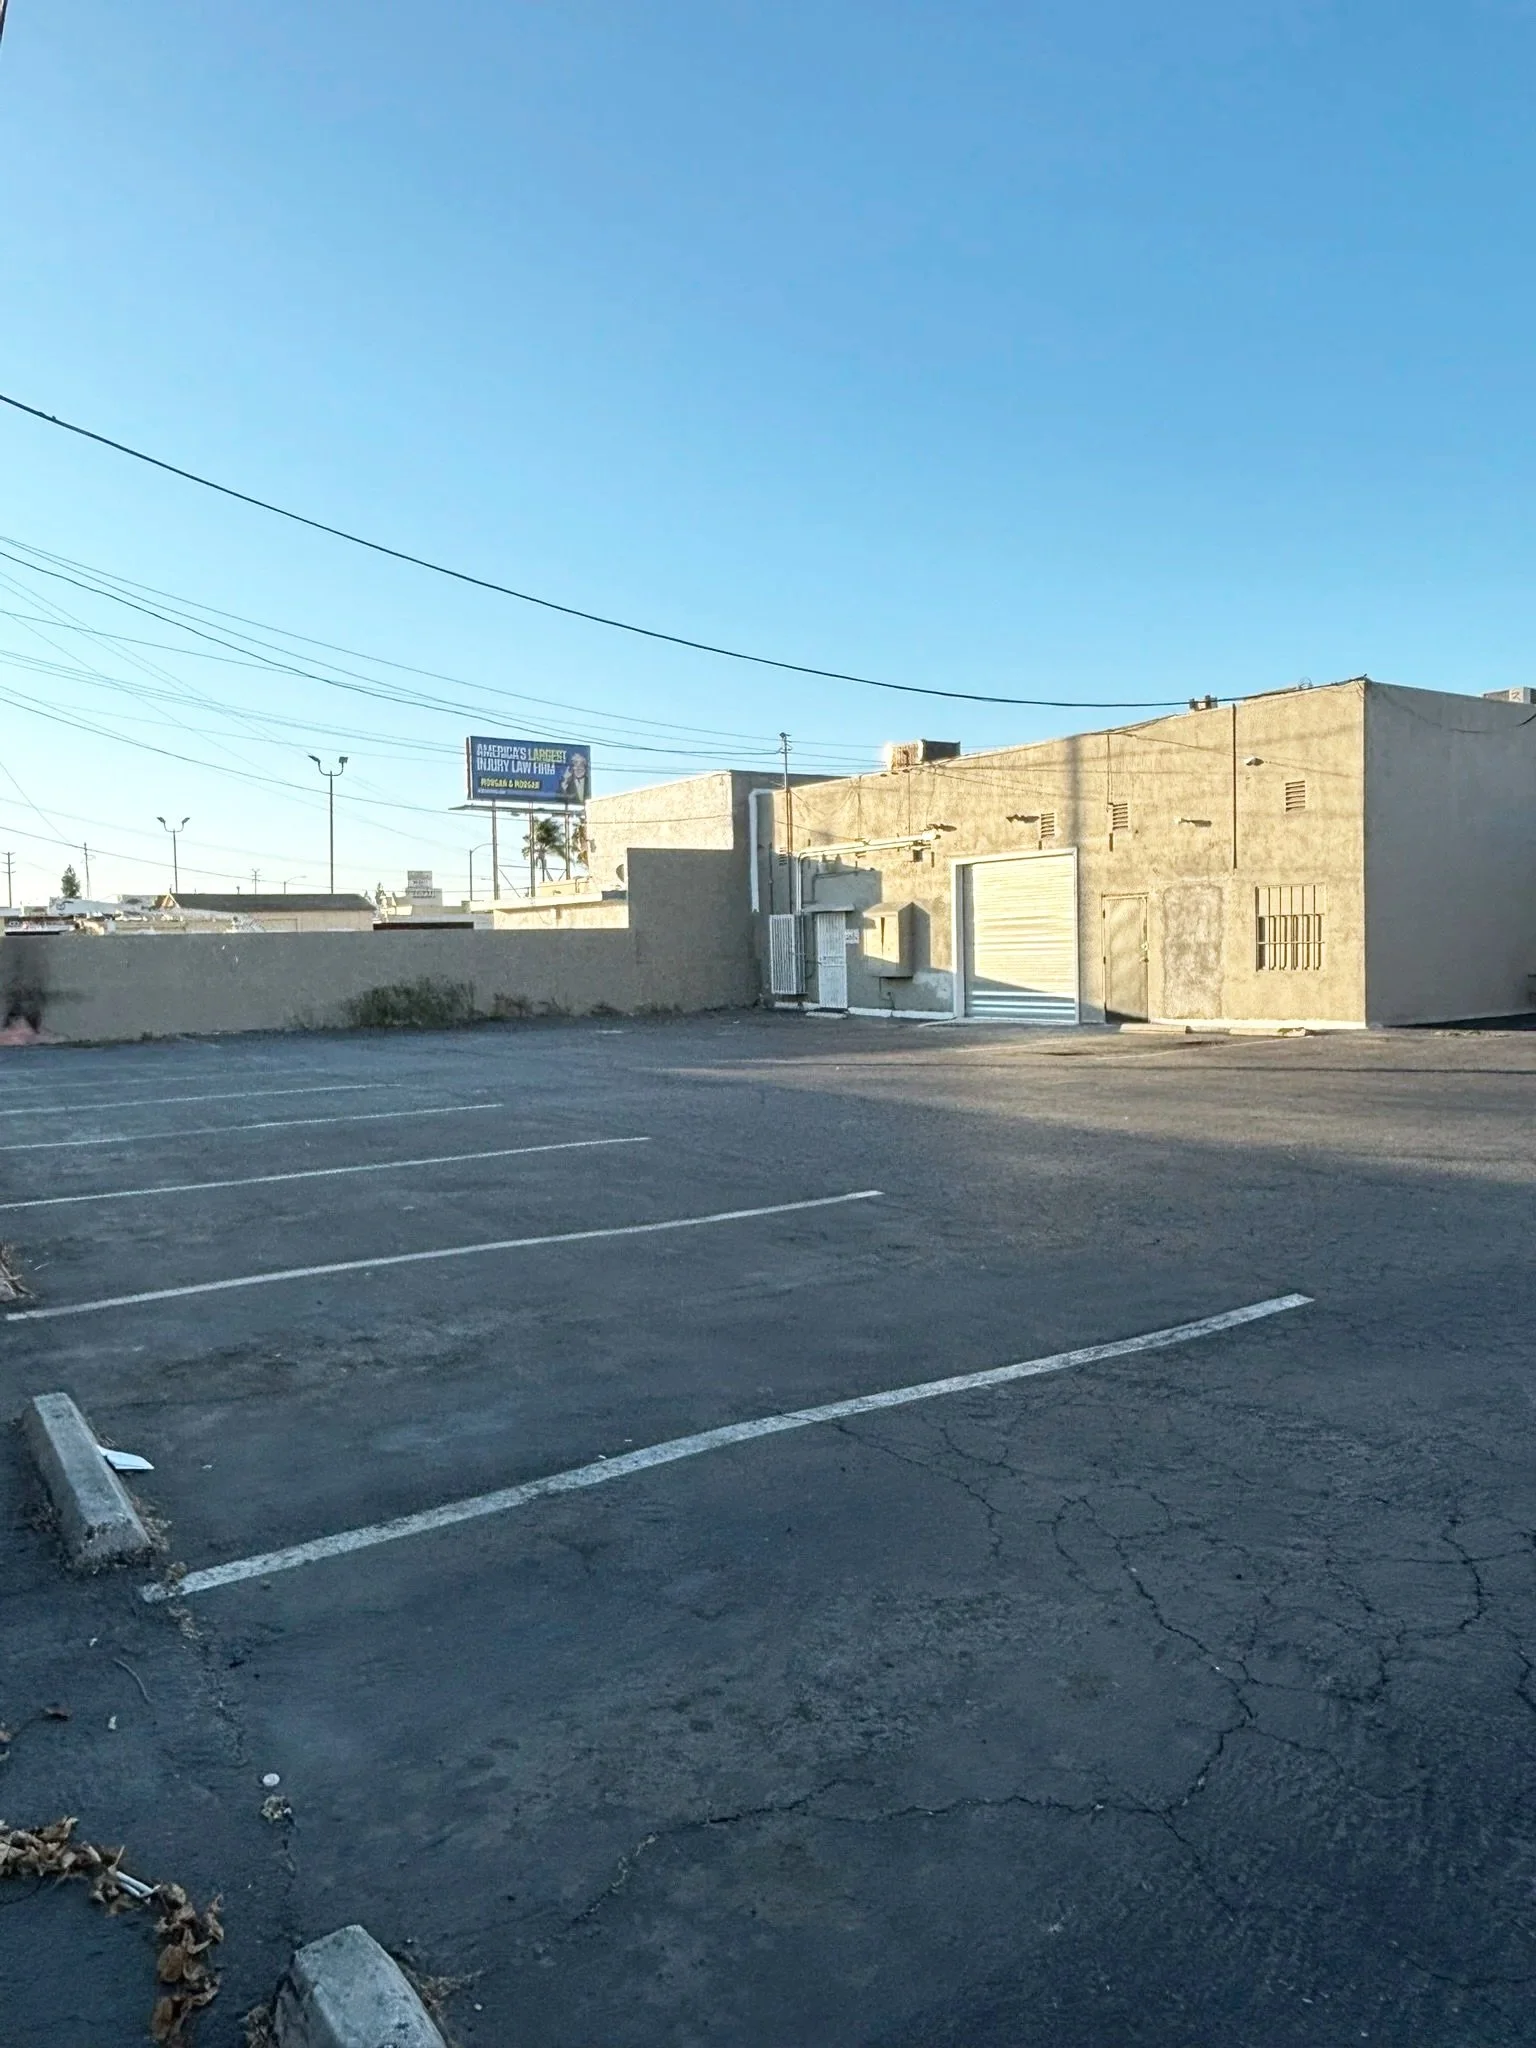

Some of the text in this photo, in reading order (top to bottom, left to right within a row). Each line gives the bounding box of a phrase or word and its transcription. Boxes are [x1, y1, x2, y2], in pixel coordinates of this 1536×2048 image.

[476, 743, 567, 764] AMERICA'S LARGEST
[476, 757, 556, 775] INJURY LAW FIRM
[480, 778, 508, 787] MORGAN
[514, 780, 540, 790] MORGAN
